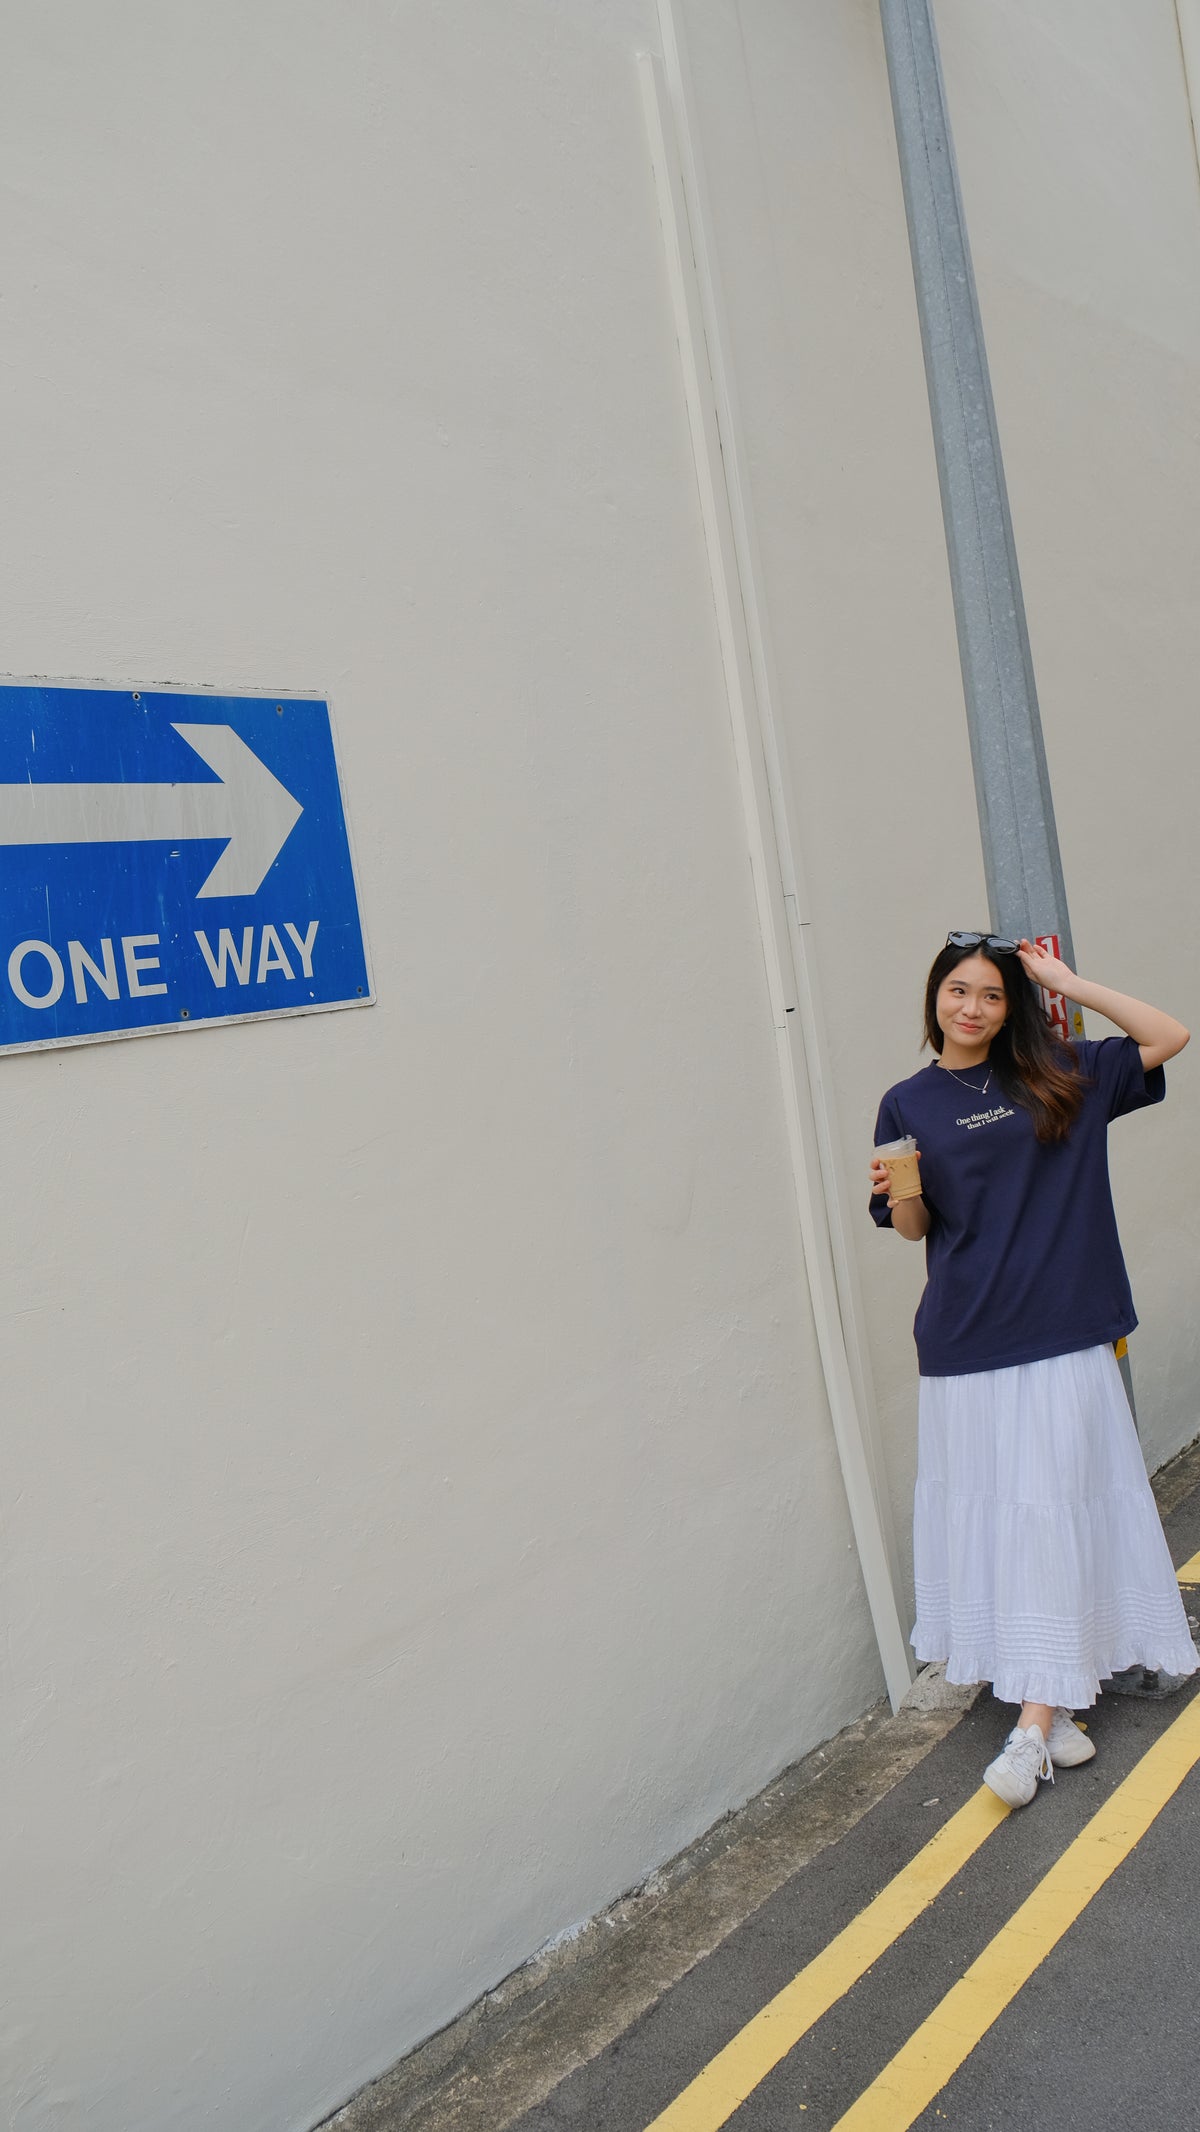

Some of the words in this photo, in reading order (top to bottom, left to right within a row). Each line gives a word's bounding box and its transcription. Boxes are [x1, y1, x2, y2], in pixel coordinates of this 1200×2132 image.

[8, 933, 168, 1009] ONE
[194, 920, 320, 988] WAY
[956, 1118, 971, 1126] One
[971, 1113, 990, 1121] thing
[989, 1109, 993, 1117] I
[993, 1106, 1006, 1115] ask
[967, 1121, 982, 1129] that
[986, 1115, 999, 1123] will
[999, 1109, 1015, 1119] seek
